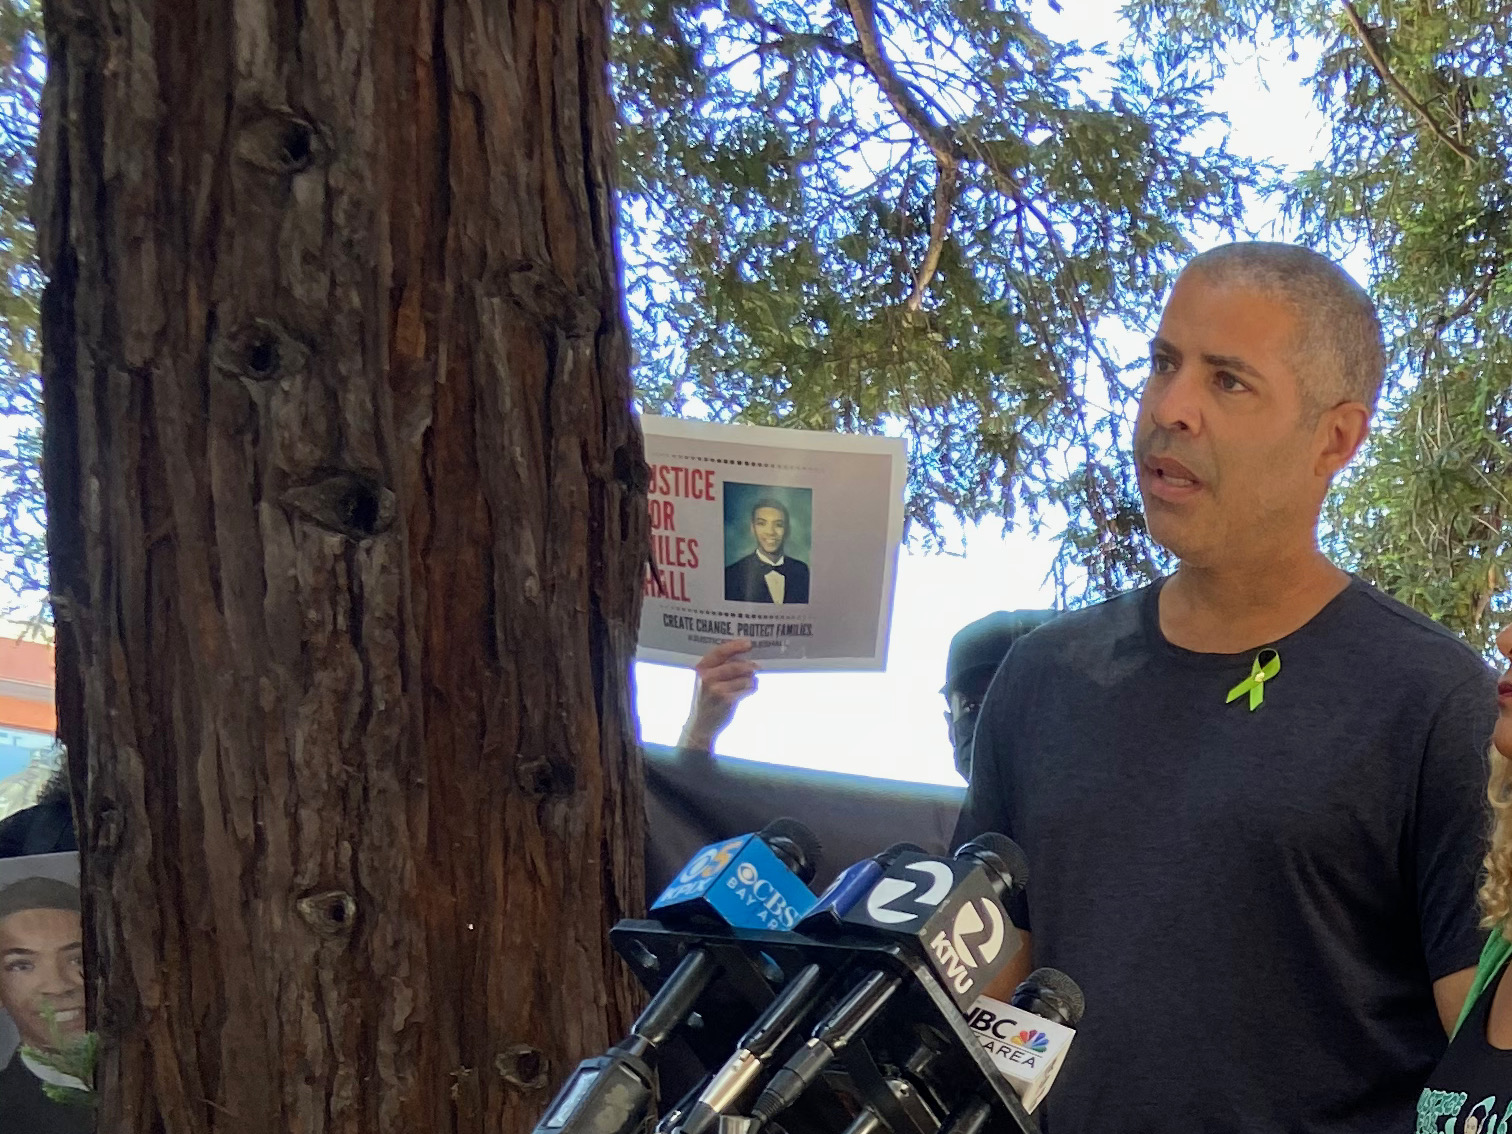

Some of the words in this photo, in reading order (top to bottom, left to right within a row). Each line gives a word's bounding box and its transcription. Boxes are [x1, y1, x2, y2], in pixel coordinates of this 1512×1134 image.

[649, 500, 676, 531] OR
[663, 613, 695, 631] CREATE
[737, 622, 774, 637] PROTECT
[726, 876, 757, 906] BAY
[753, 879, 800, 928] CBS
[930, 930, 974, 994] KTVU
[982, 1040, 1036, 1069] AREA
